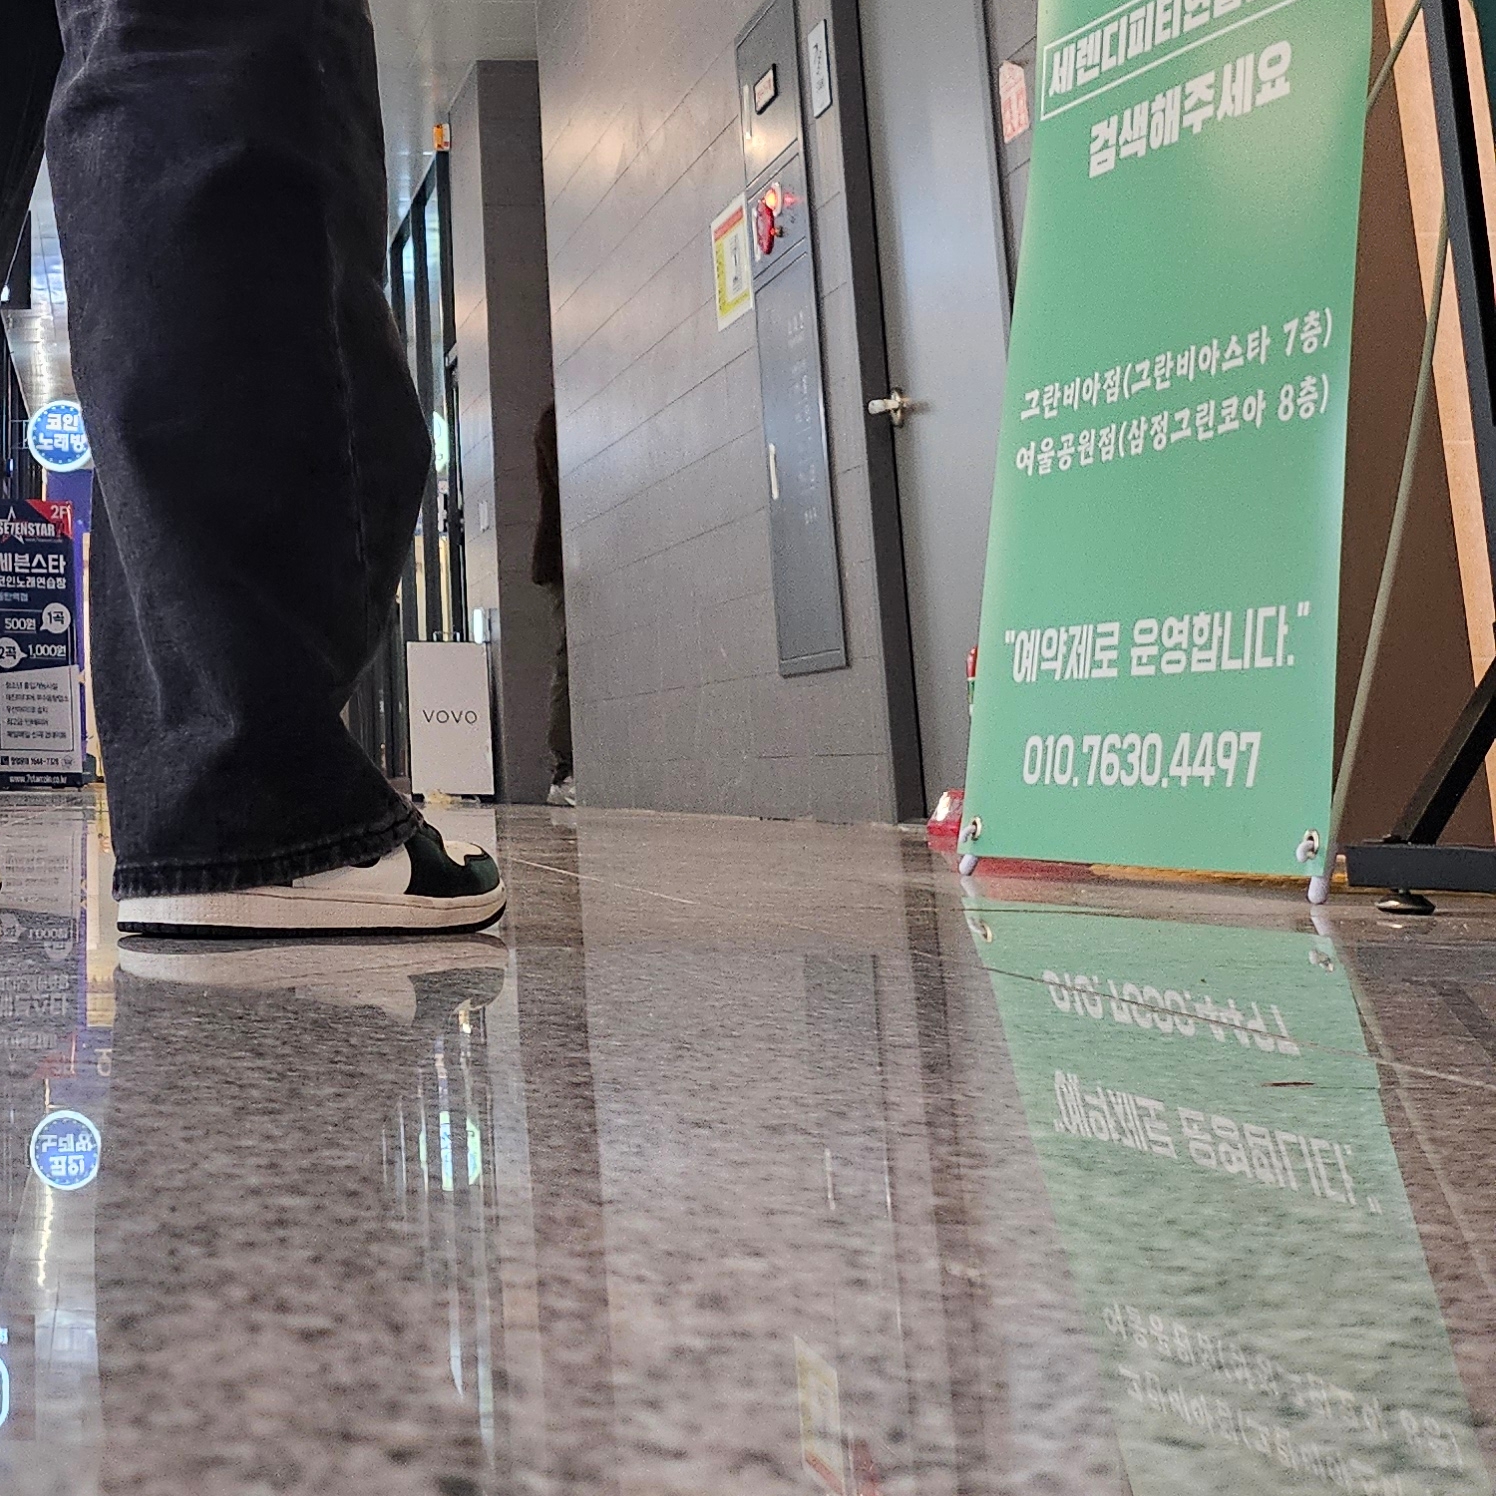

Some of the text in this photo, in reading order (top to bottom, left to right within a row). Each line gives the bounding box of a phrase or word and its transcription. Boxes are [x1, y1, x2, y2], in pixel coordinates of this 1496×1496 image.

[1088, 39, 1292, 179] 검색해주세요
[1020, 306, 1333, 421] 그란비아점(그란비아스타 7층)
[35, 432, 87, 453] 노래방
[45, 413, 79, 432] 코인
[1015, 372, 1330, 476] 여울공원점(삼정그린코아 8층)
[4, 610, 65, 631] 500원 1곡
[28, 643, 67, 658] 1,000원
[1004, 600, 1310, 683] "예약제로 운영합니다."
[422, 709, 478, 724] VOVO
[1022, 730, 1262, 789] 010.7630.4497
